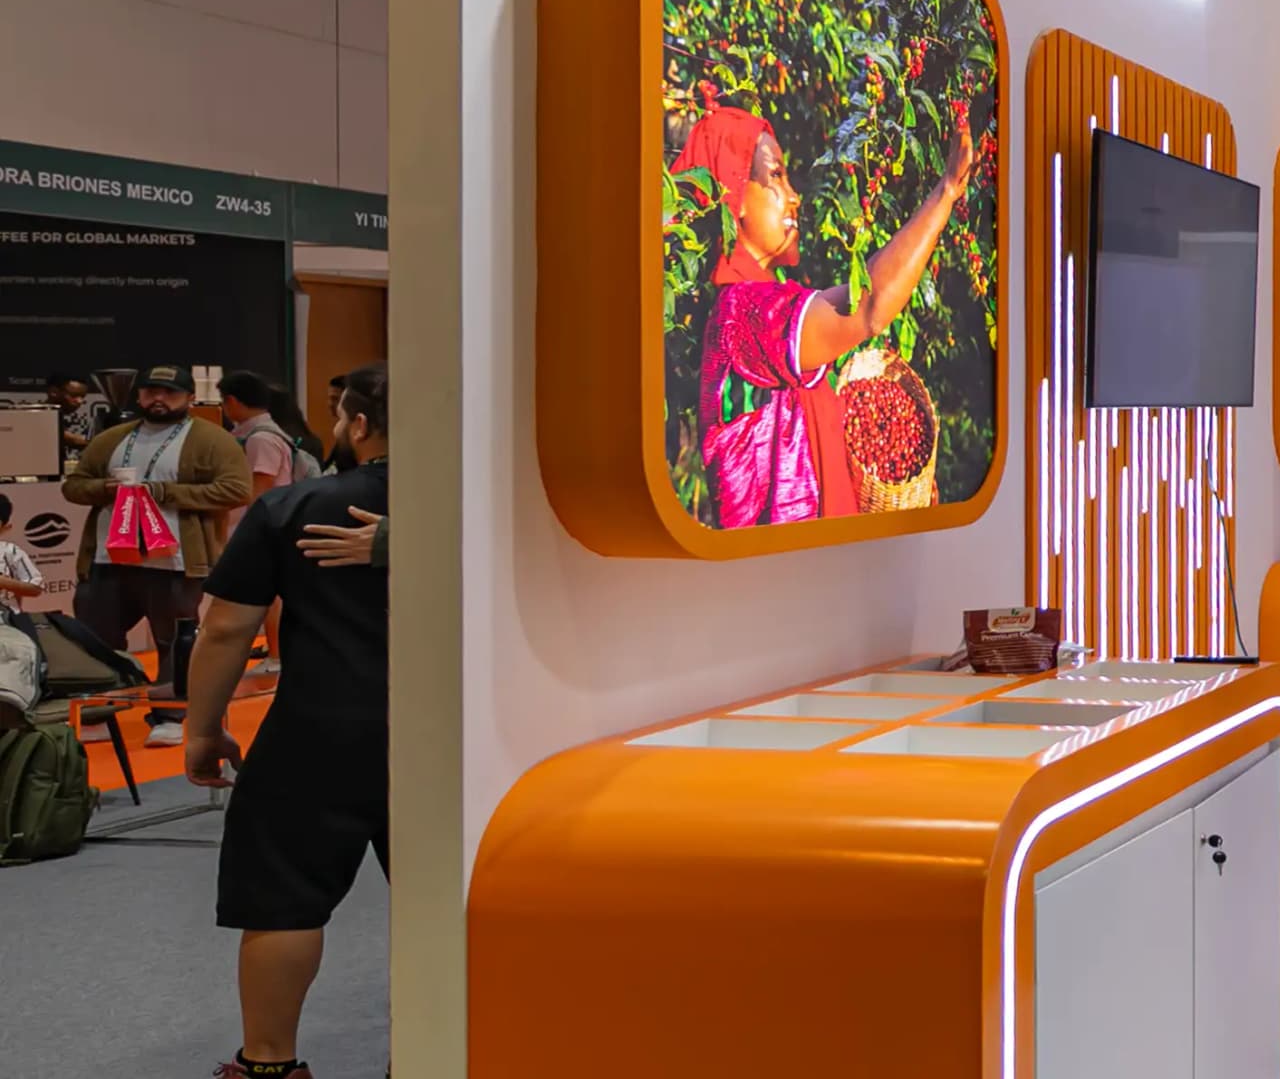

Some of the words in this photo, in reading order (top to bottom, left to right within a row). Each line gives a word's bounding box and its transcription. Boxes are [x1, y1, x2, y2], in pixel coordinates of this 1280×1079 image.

[38, 172, 122, 197] BRIONES
[127, 183, 194, 206] MEXICO
[215, 195, 272, 216] ZW4-35
[32, 232, 62, 244] FOR
[65, 232, 124, 245] GLOBAL
[127, 234, 196, 246] MARKETS
[85, 276, 125, 287] directly
[127, 276, 154, 286] from
[156, 278, 189, 289] origin
